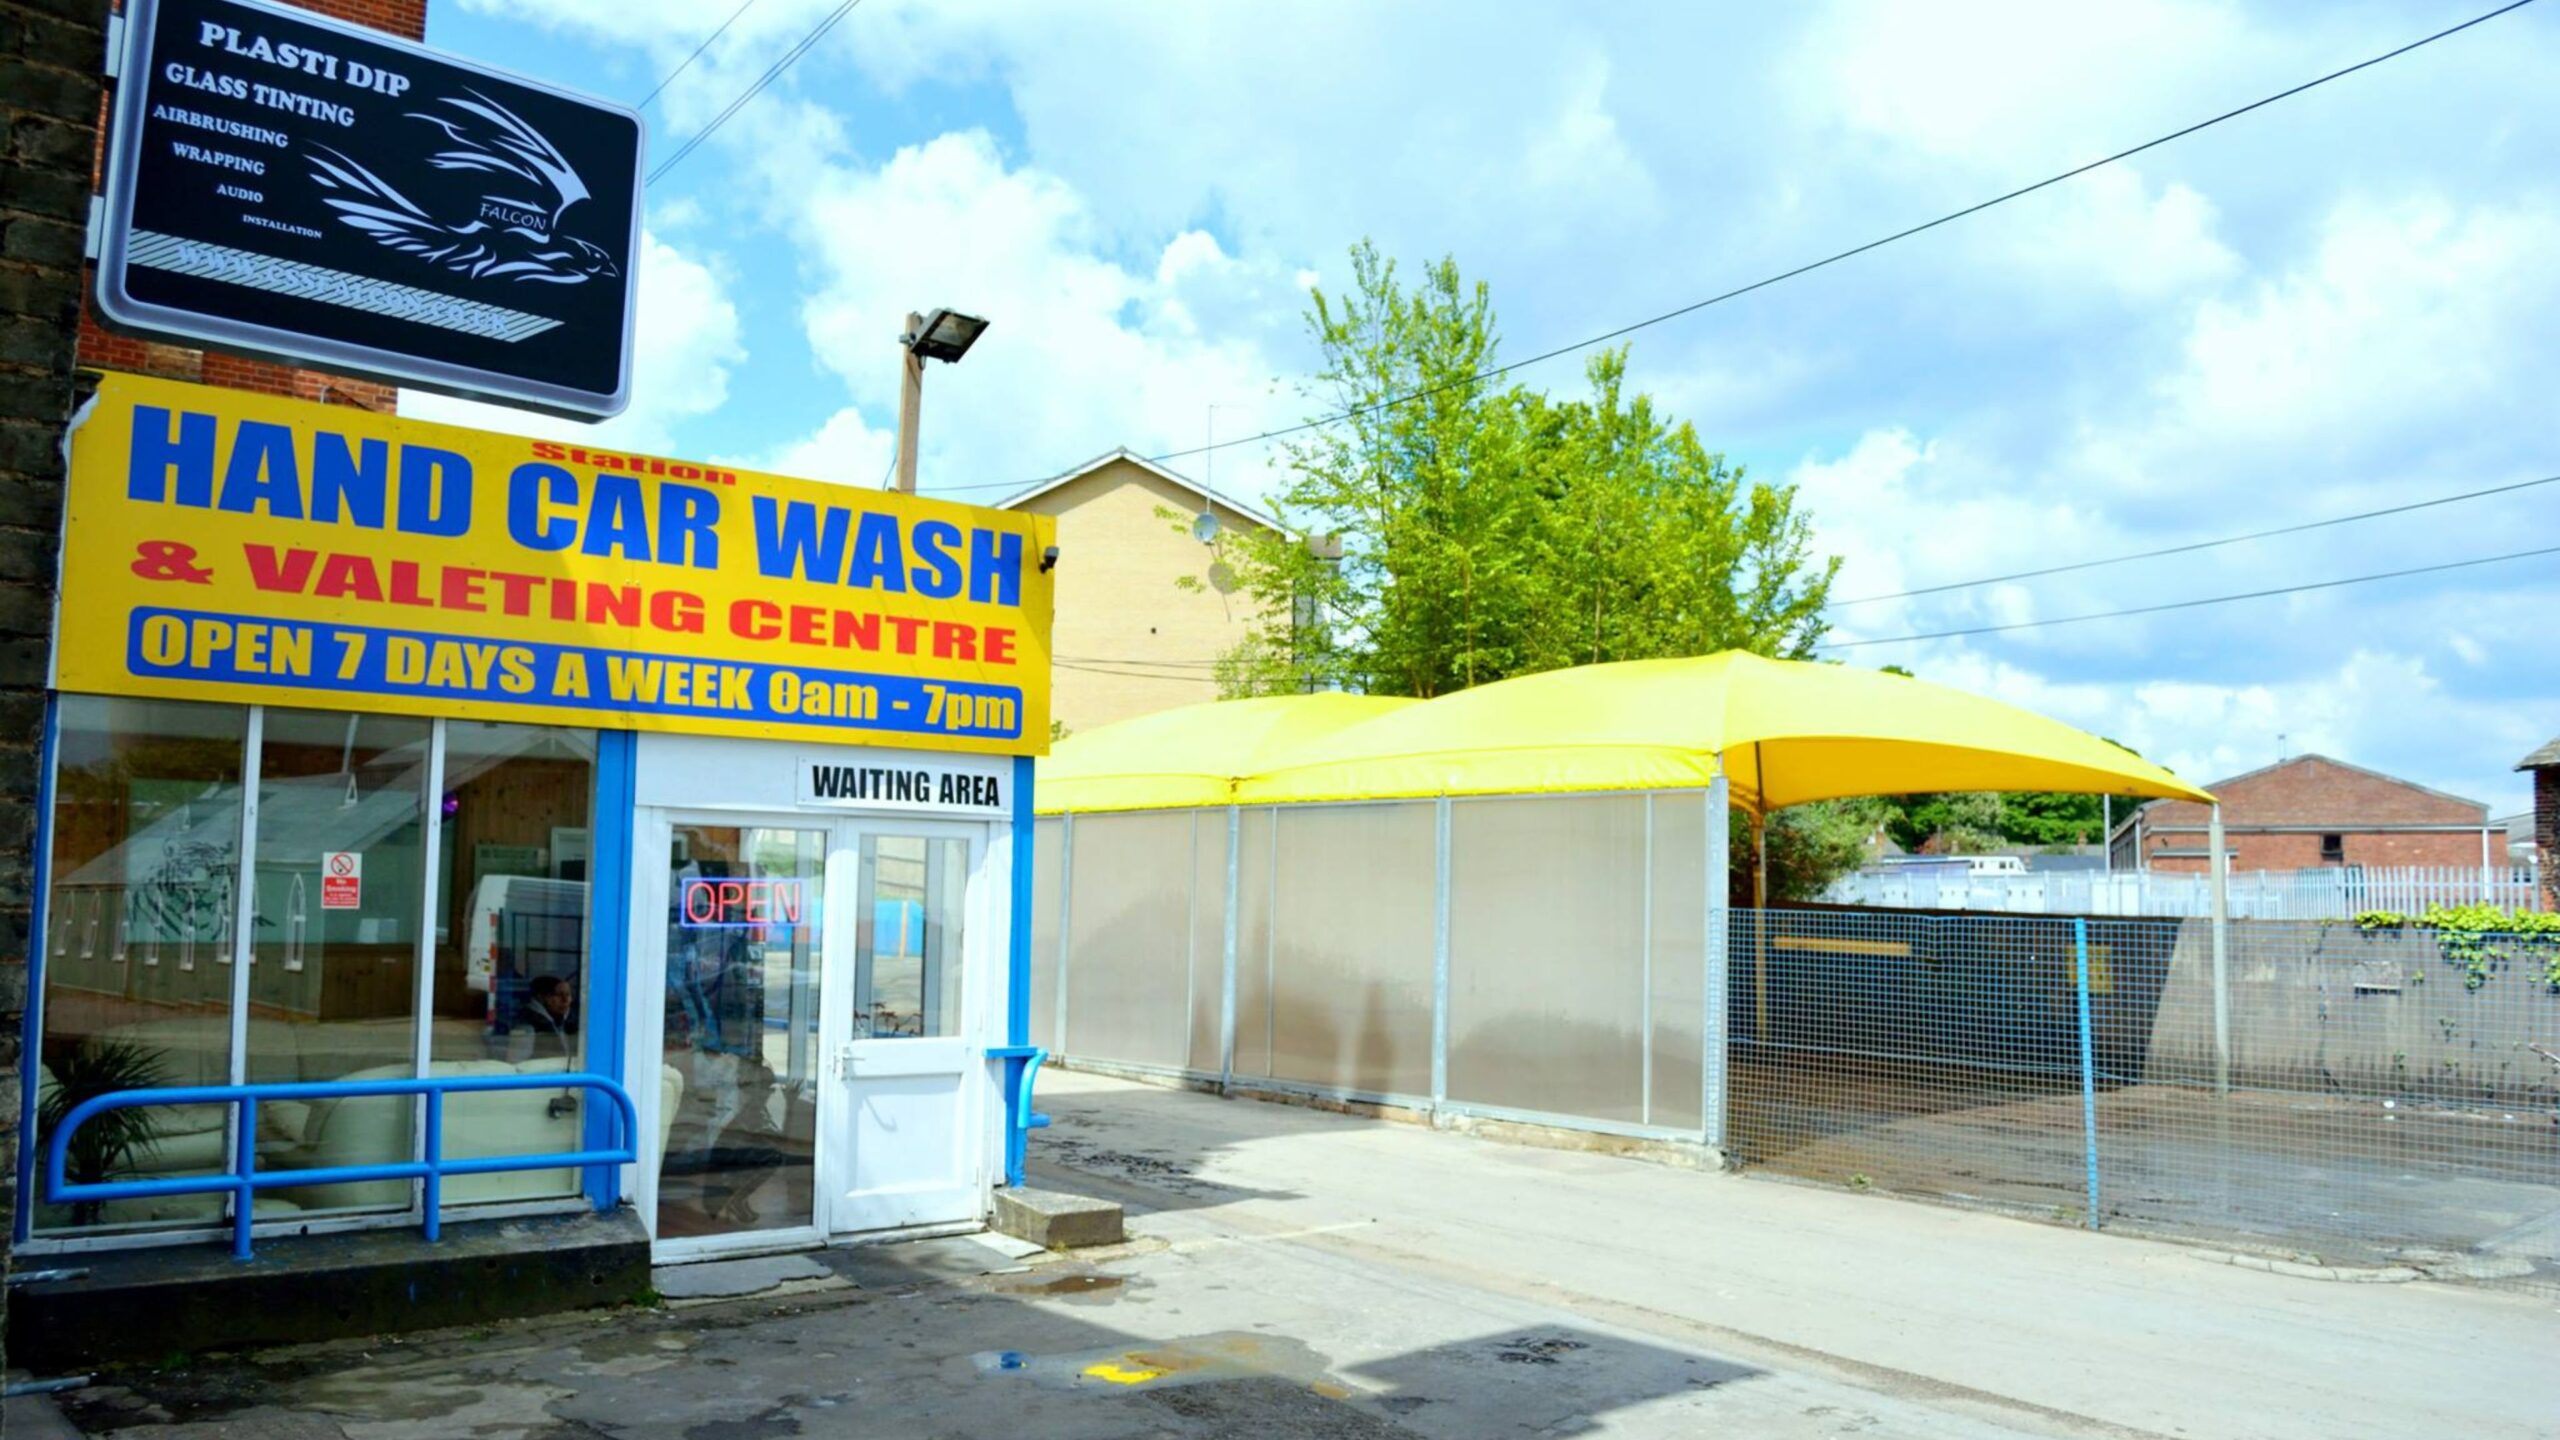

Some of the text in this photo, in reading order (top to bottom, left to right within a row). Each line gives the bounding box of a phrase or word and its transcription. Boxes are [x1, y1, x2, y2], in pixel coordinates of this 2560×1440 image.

[200, 21, 411, 98] PLASTI DIP
[166, 63, 355, 128] GLASS TINTING
[153, 104, 289, 148] AIRBRUSHING
[173, 142, 265, 176] WRAPPING
[216, 183, 264, 203] AUDIO
[242, 214, 323, 239] INSTALLATION
[479, 202, 547, 231] FALCON
[532, 442, 736, 485] Station
[128, 405, 1022, 606] HAND CAR WASH
[130, 540, 1016, 665] & VALETING CENTRE
[141, 615, 313, 676] OPEN
[334, 632, 367, 680] 7
[385, 637, 536, 693] DAYS
[552, 653, 590, 698] A
[606, 656, 752, 711] WEEK
[923, 684, 1016, 730] 7pm
[812, 765, 1000, 806] WAITING AREA
[686, 882, 800, 923] OPEN
